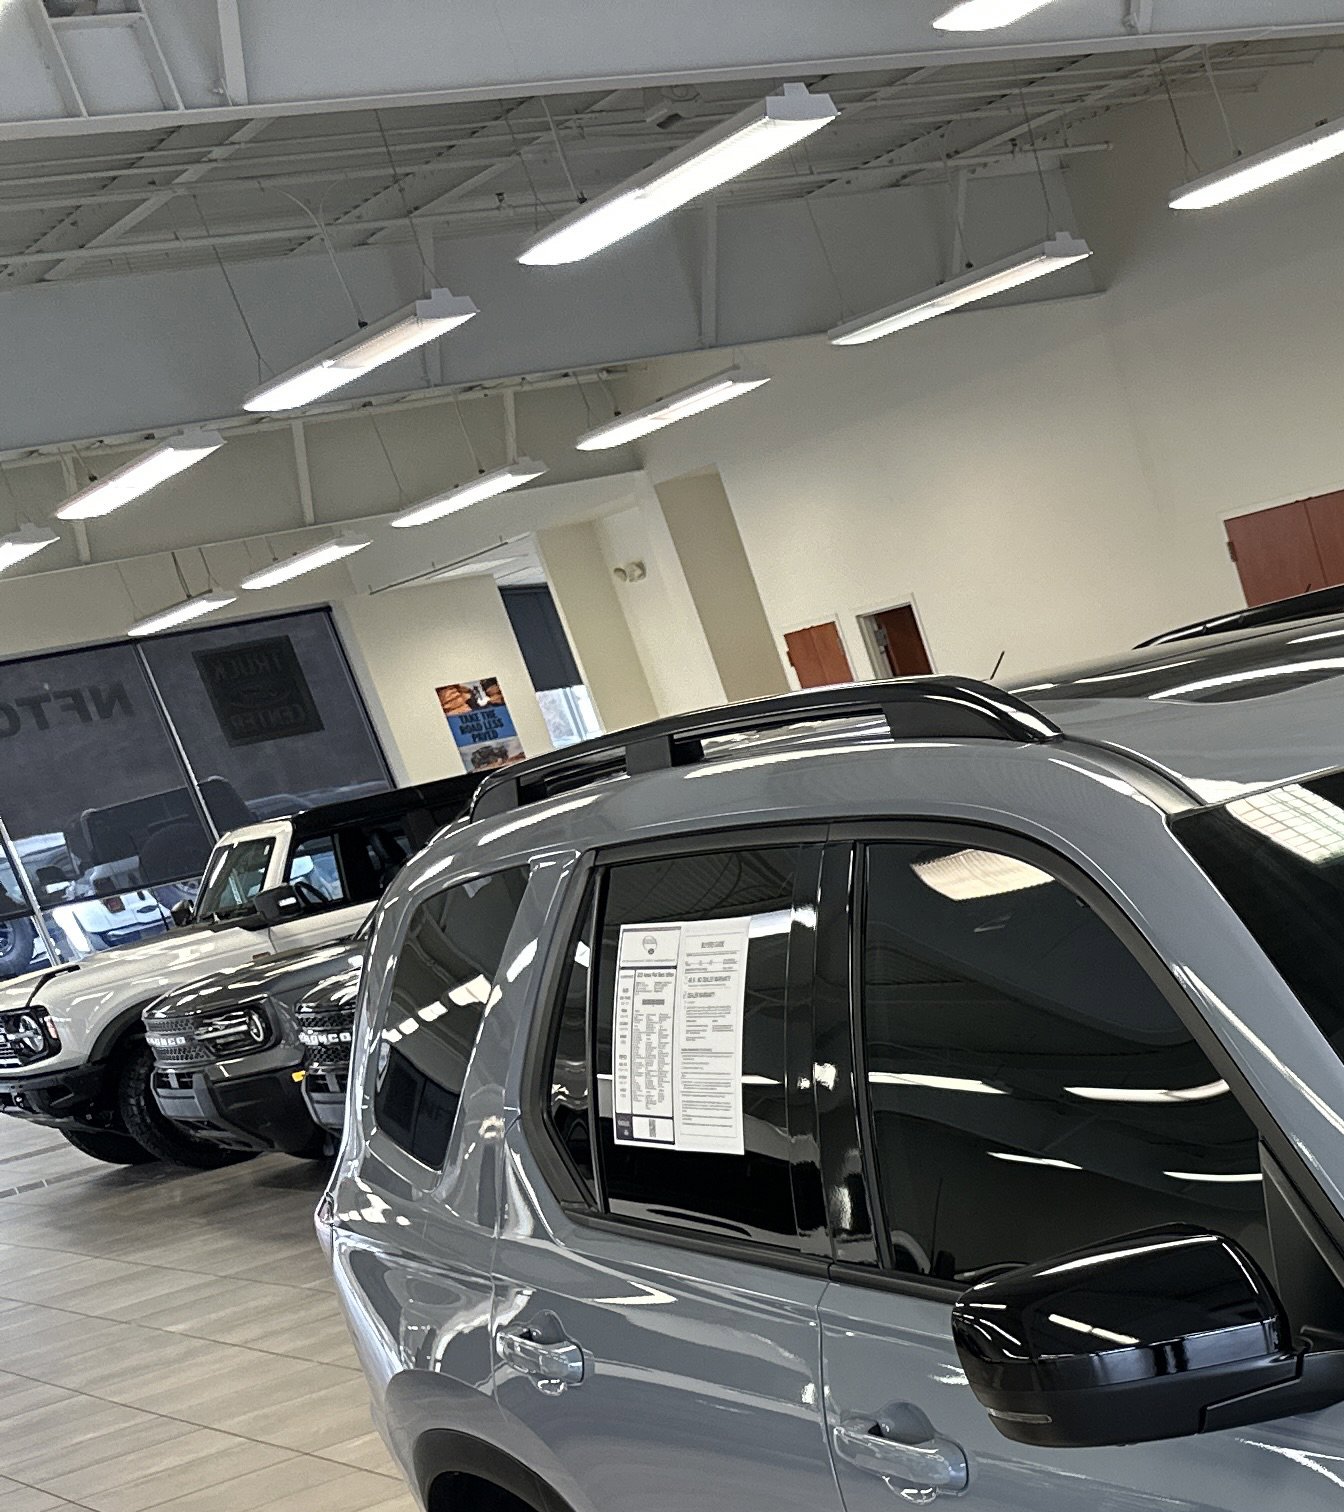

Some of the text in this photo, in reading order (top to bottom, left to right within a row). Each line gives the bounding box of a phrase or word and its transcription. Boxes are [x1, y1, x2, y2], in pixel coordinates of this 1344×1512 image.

[459, 710, 497, 723] TAKE THE
[459, 719, 504, 735] ROAD LESS
[471, 731, 498, 743] PAVED
